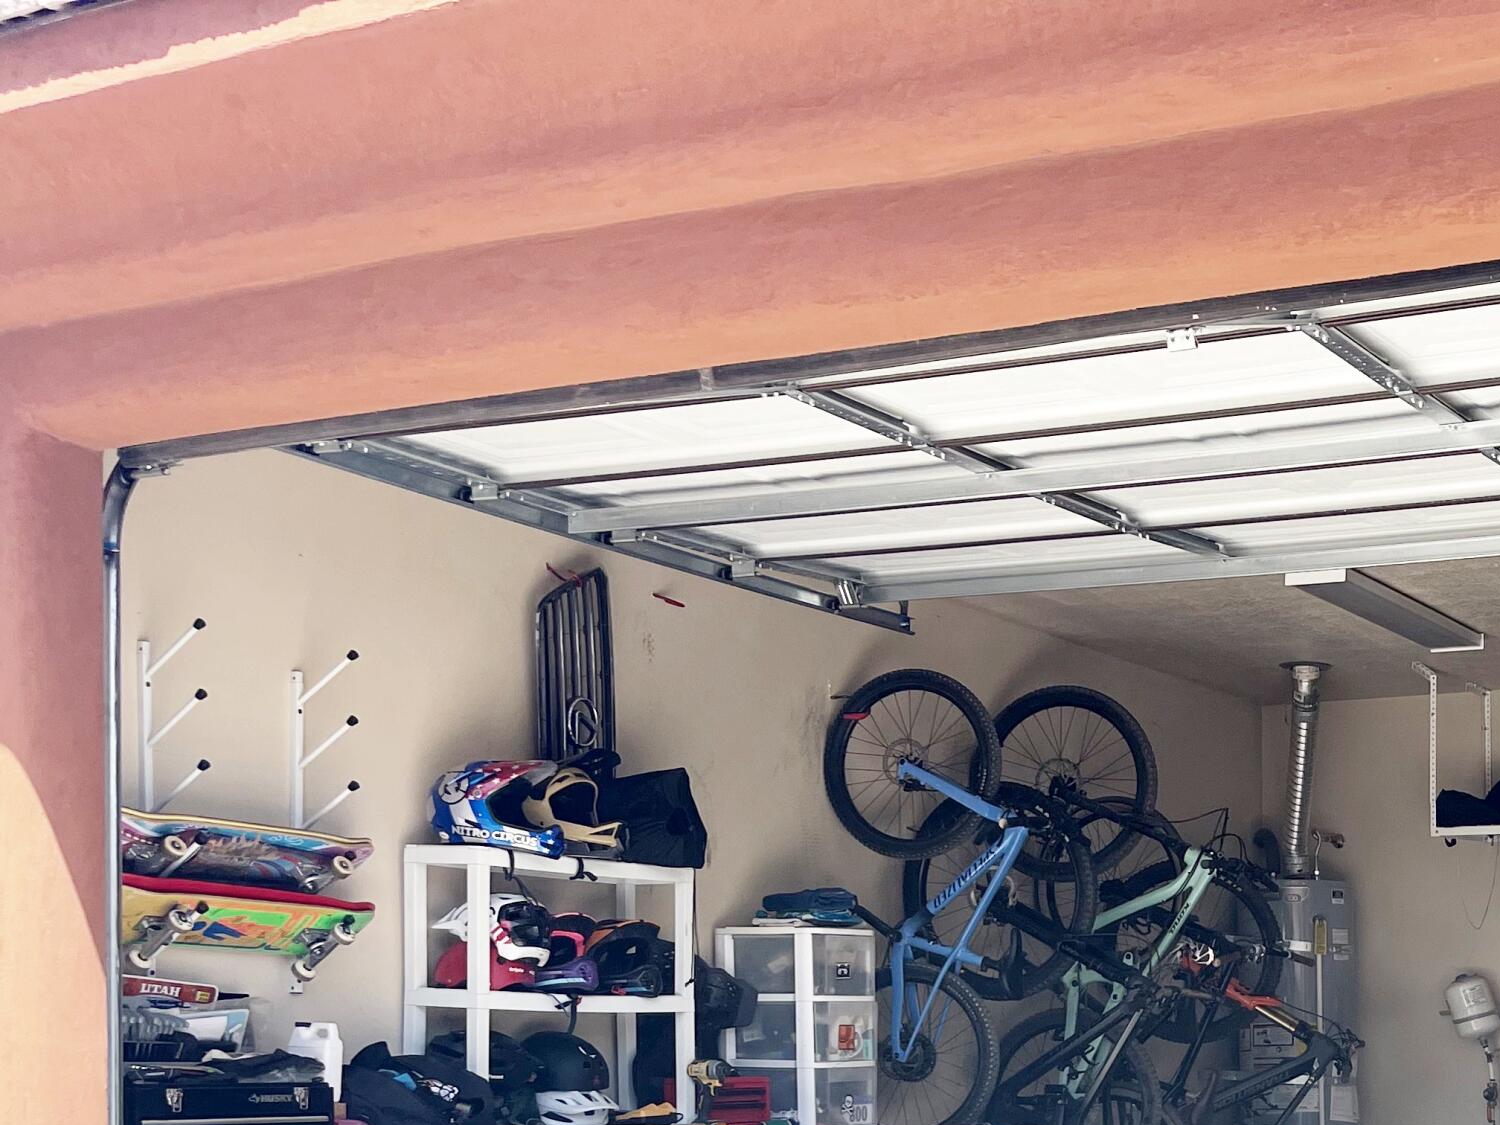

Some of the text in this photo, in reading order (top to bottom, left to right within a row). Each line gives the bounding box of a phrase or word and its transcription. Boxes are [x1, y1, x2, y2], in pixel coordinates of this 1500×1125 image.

[451, 825, 538, 847] NITRO CIRCUS
[139, 982, 181, 997] UTAH
[260, 1094, 293, 1103] HUSKY
